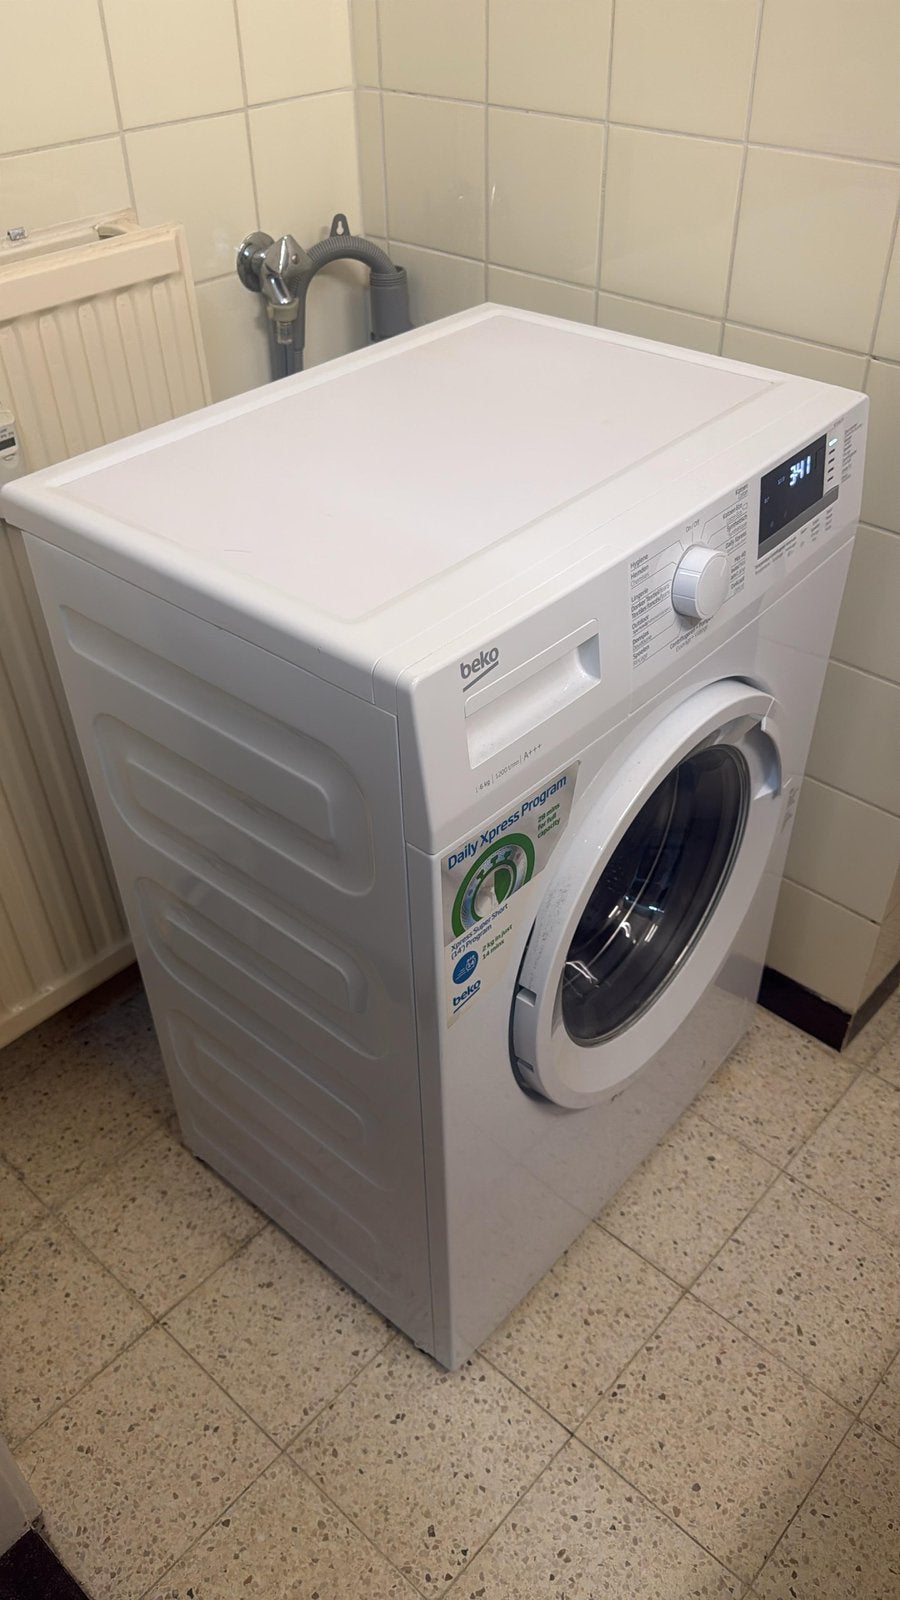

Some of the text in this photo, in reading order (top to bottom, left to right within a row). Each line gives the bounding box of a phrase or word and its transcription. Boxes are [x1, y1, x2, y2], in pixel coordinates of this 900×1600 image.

[460, 647, 499, 680] beko
[448, 776, 567, 870] Daily Xpress Program
[537, 811, 557, 831] for full
[537, 818, 561, 839] capacity
[450, 903, 508, 952] Xpress Super Short
[466, 924, 493, 948] Program
[482, 944, 487, 952] 2
[487, 938, 495, 949] kg
[500, 924, 513, 940] just
[482, 938, 505, 960] 14 mins
[452, 979, 481, 1007] beko
